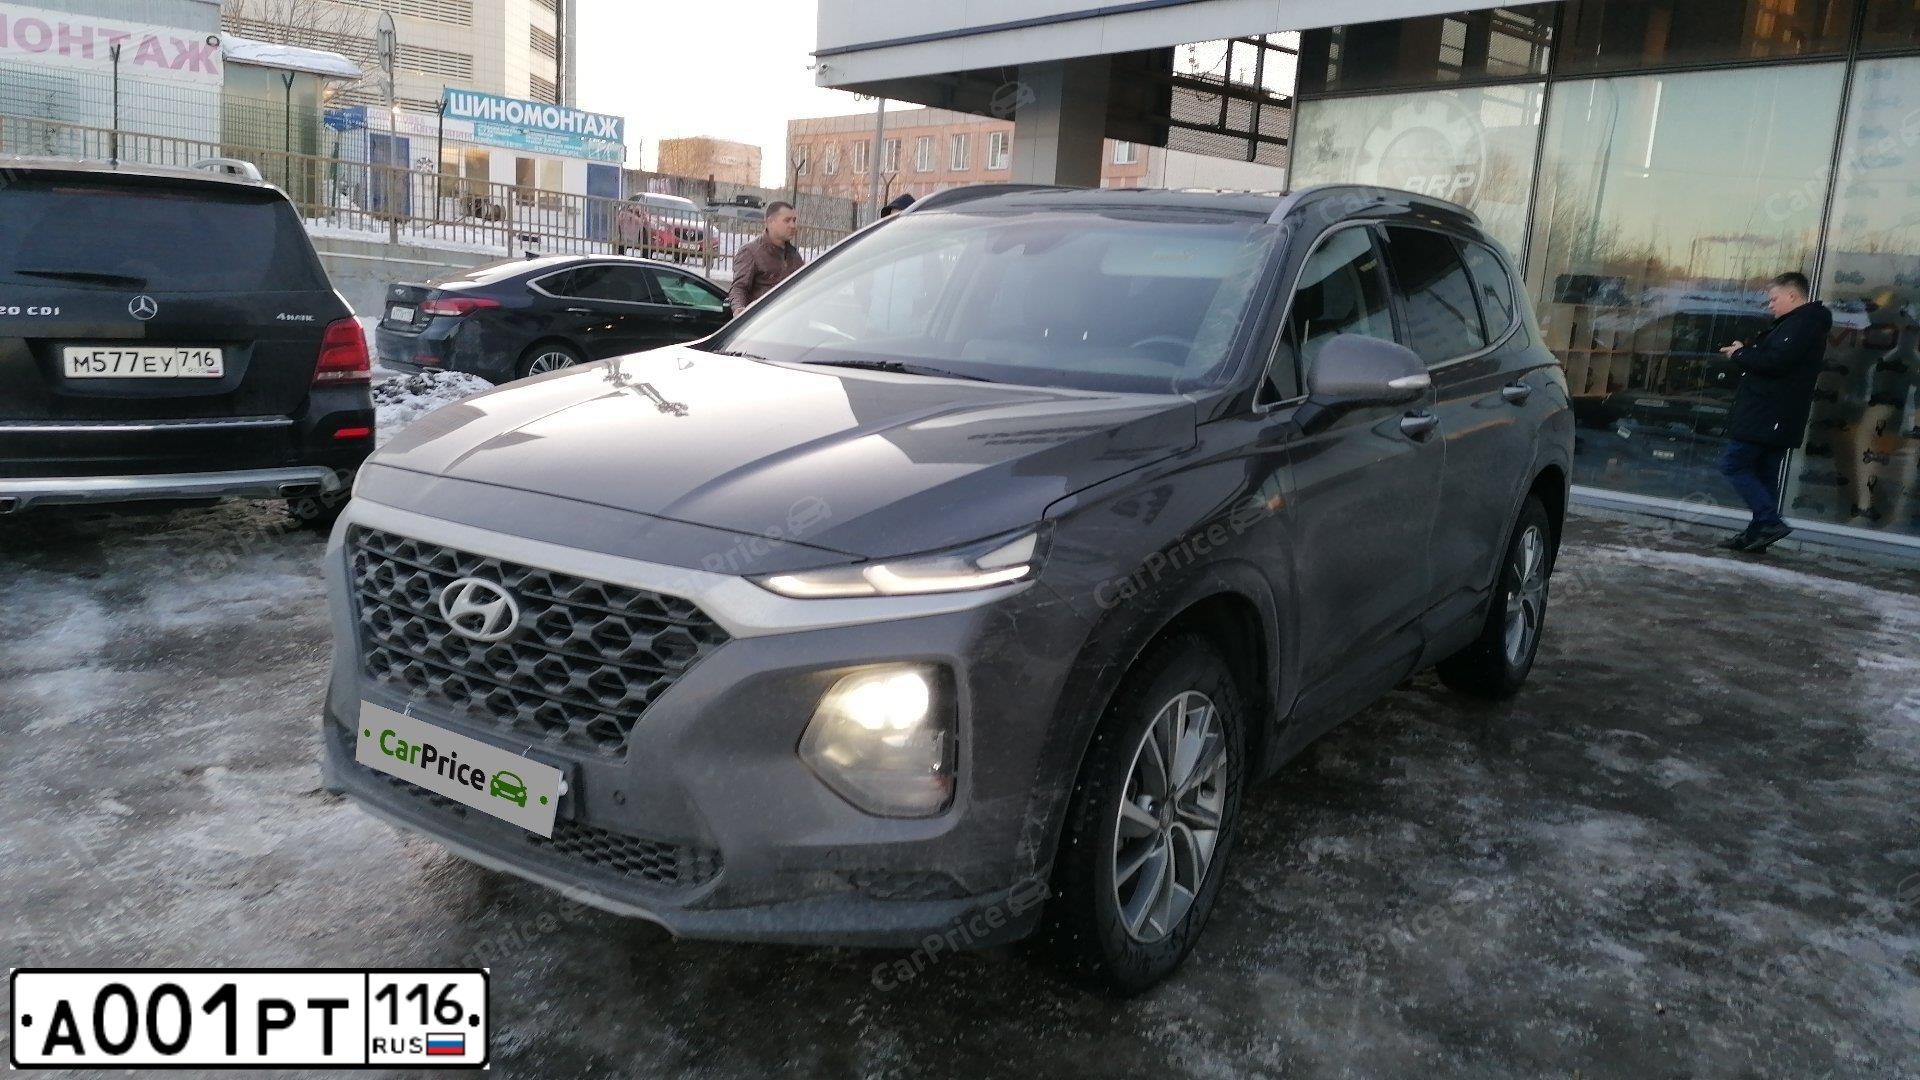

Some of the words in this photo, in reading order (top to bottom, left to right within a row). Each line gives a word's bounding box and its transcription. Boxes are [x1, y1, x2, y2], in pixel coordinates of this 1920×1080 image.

[450, 92, 618, 140] ШИНОМОНТАЖ
[26, 306, 60, 316] CDI
[178, 351, 215, 367] 716
